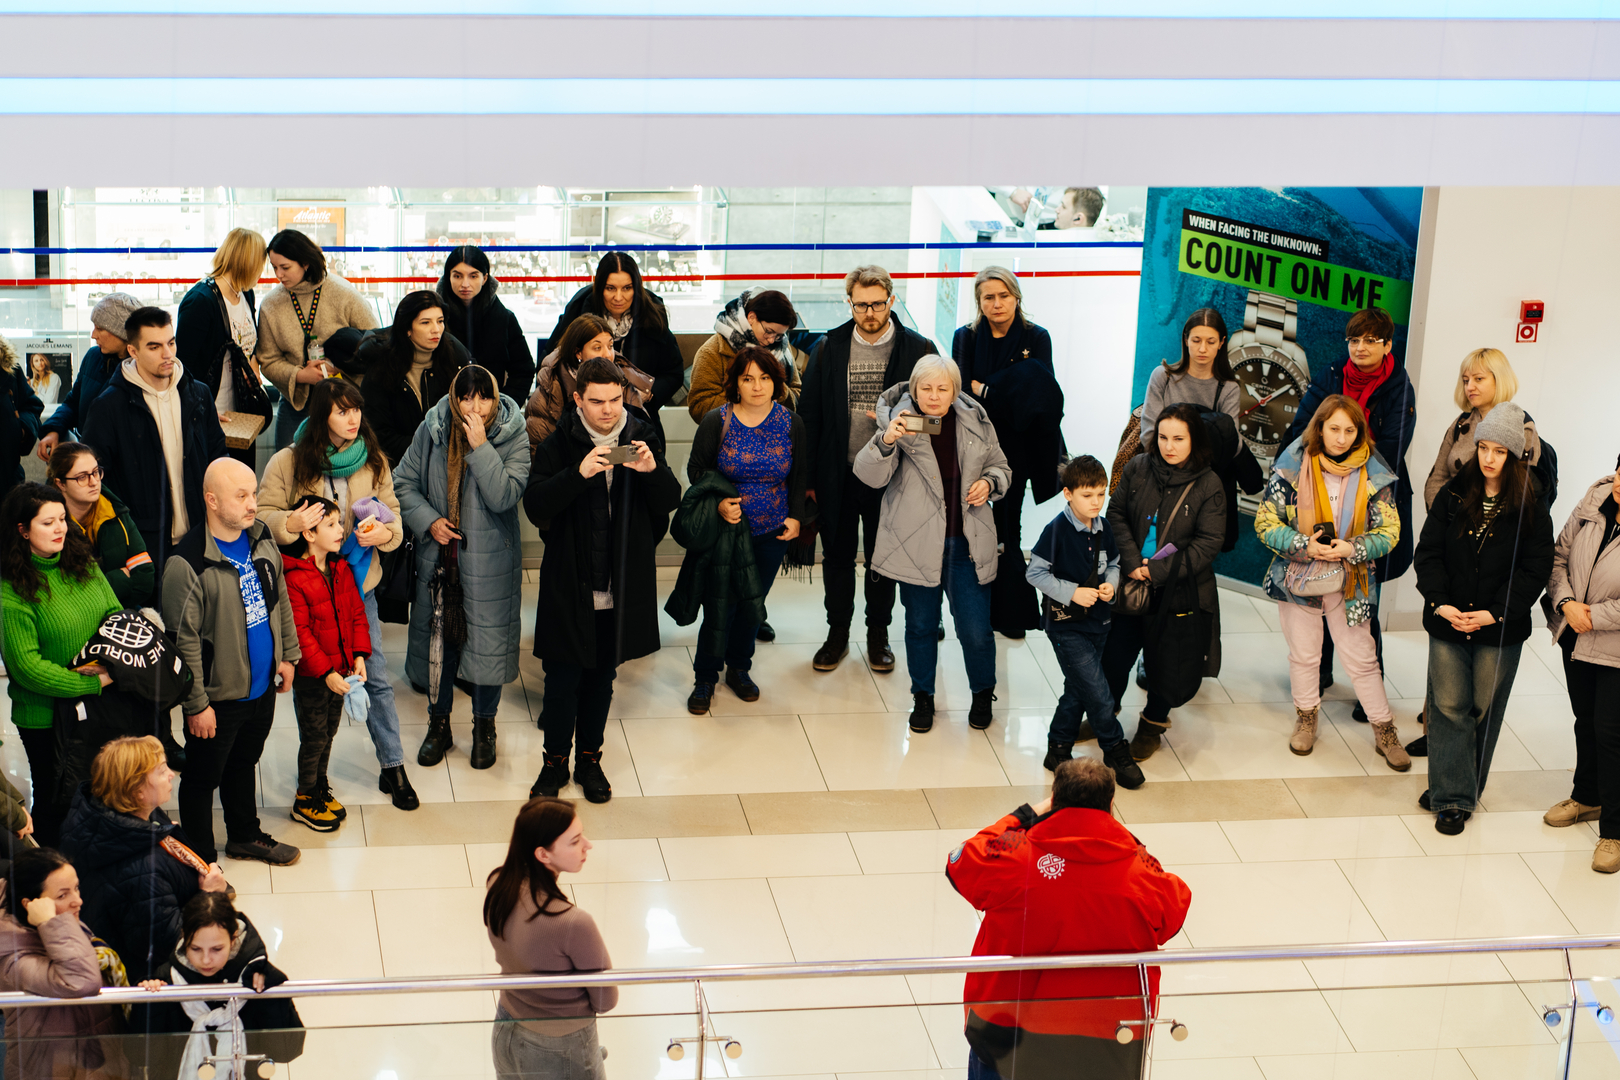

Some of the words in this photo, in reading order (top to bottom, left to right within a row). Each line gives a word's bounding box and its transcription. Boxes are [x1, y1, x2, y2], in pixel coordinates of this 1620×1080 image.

[1188, 214, 1217, 232] WHEN
[1217, 221, 1251, 239] FACING
[1252, 229, 1269, 244] THE
[1270, 233, 1322, 256] UNKNOWN:
[1186, 237, 1282, 288] COUNT
[1290, 261, 1331, 301] ON
[1341, 272, 1384, 309] ME
[89, 644, 147, 668] WORLD
[147, 639, 166, 665] HE
